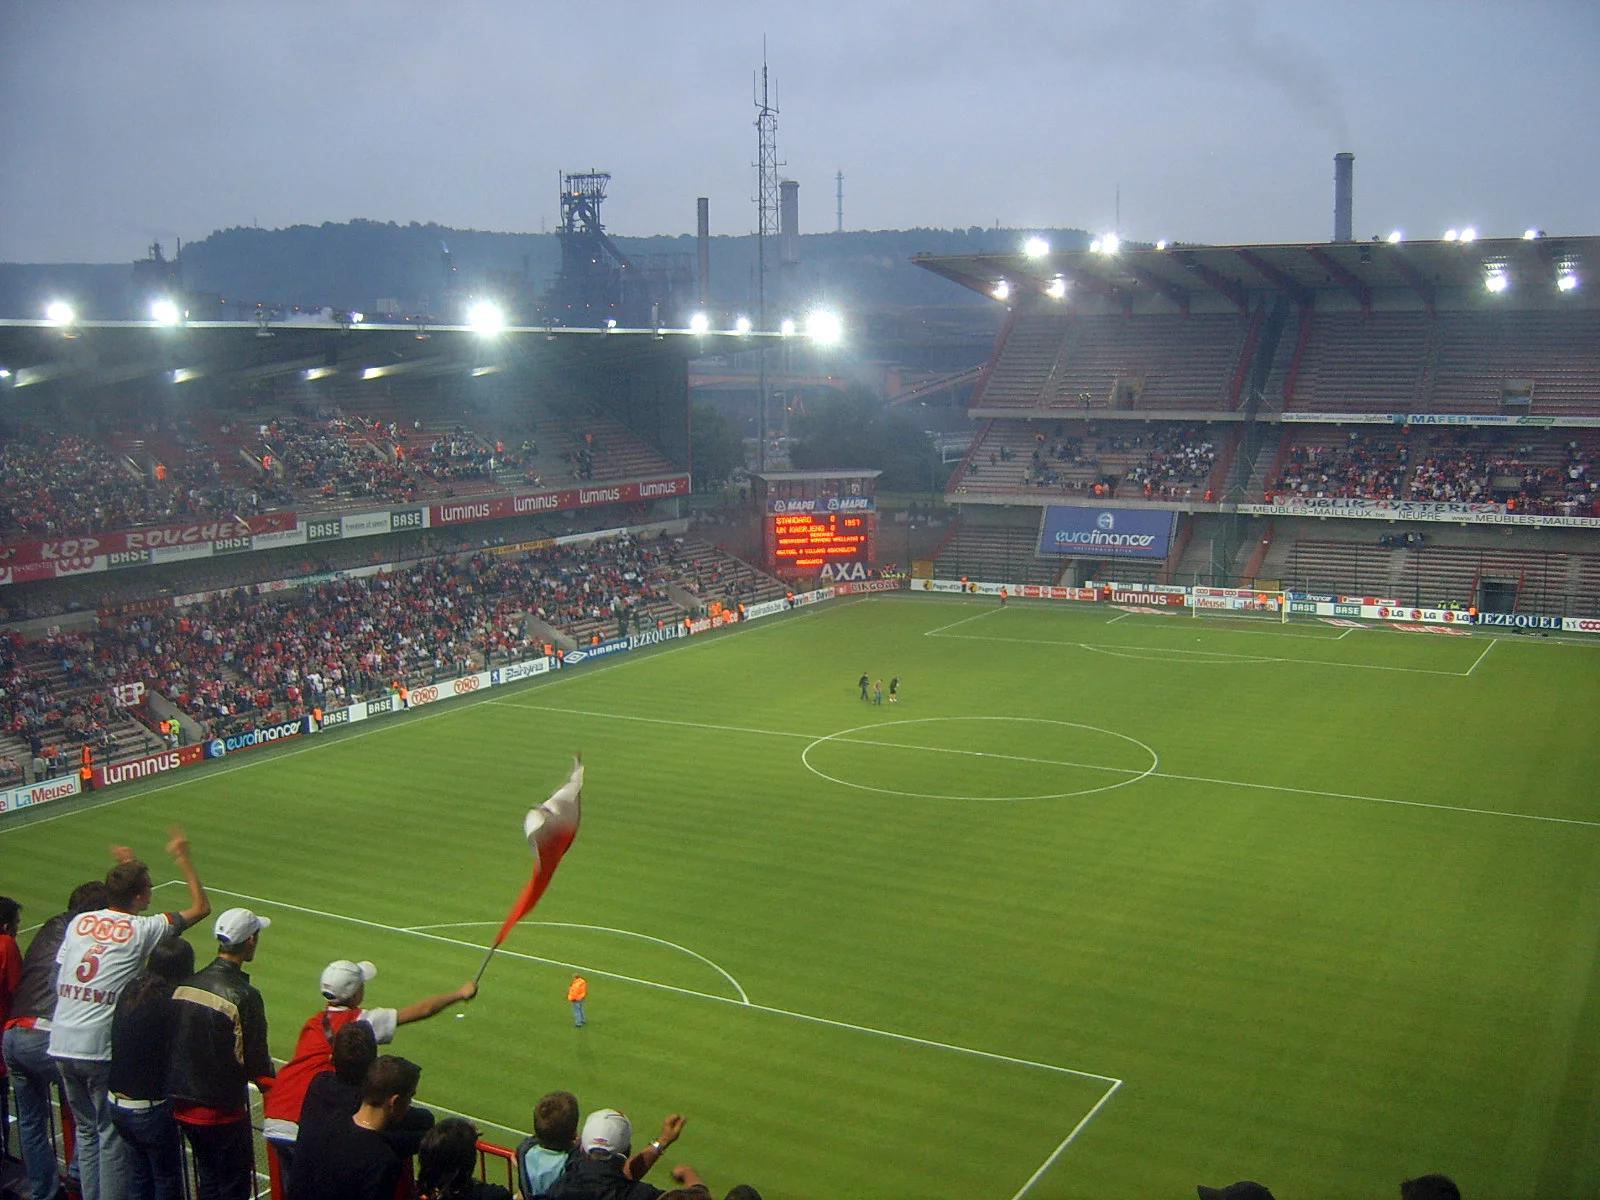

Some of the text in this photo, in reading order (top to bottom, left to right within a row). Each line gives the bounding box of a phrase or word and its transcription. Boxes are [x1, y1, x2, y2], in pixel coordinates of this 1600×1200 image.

[1411, 415, 1468, 424] MAFER
[580, 488, 620, 504] luminus
[640, 481, 676, 496] luminus
[513, 495, 558, 512] luminus
[787, 501, 815, 511] MAPEI
[840, 499, 867, 509] MAPEI
[393, 513, 420, 527] BASE
[440, 504, 490, 522] luminus
[776, 516, 812, 525] STANDARD
[309, 522, 341, 538] BASE
[1055, 529, 1155, 546] eurofinancer
[41, 538, 100, 560] KOP
[820, 562, 866, 580] AXA
[851, 579, 900, 592] BINGOAL
[1112, 590, 1167, 605] luminus
[1292, 603, 1315, 612] BASE
[1335, 606, 1360, 615] BASE
[1456, 613, 1469, 621] LG
[1475, 612, 1560, 629] JEZEQUEL
[628, 626, 677, 650] JEZEQUEL
[455, 677, 479, 694] TNT
[412, 687, 438, 705] TNT
[368, 699, 391, 714] BASE
[323, 710, 348, 725] BASE
[227, 721, 301, 750] eurofinancer
[103, 752, 181, 785] luminus
[78, 916, 133, 942] TNT
[76, 945, 107, 983] 5
